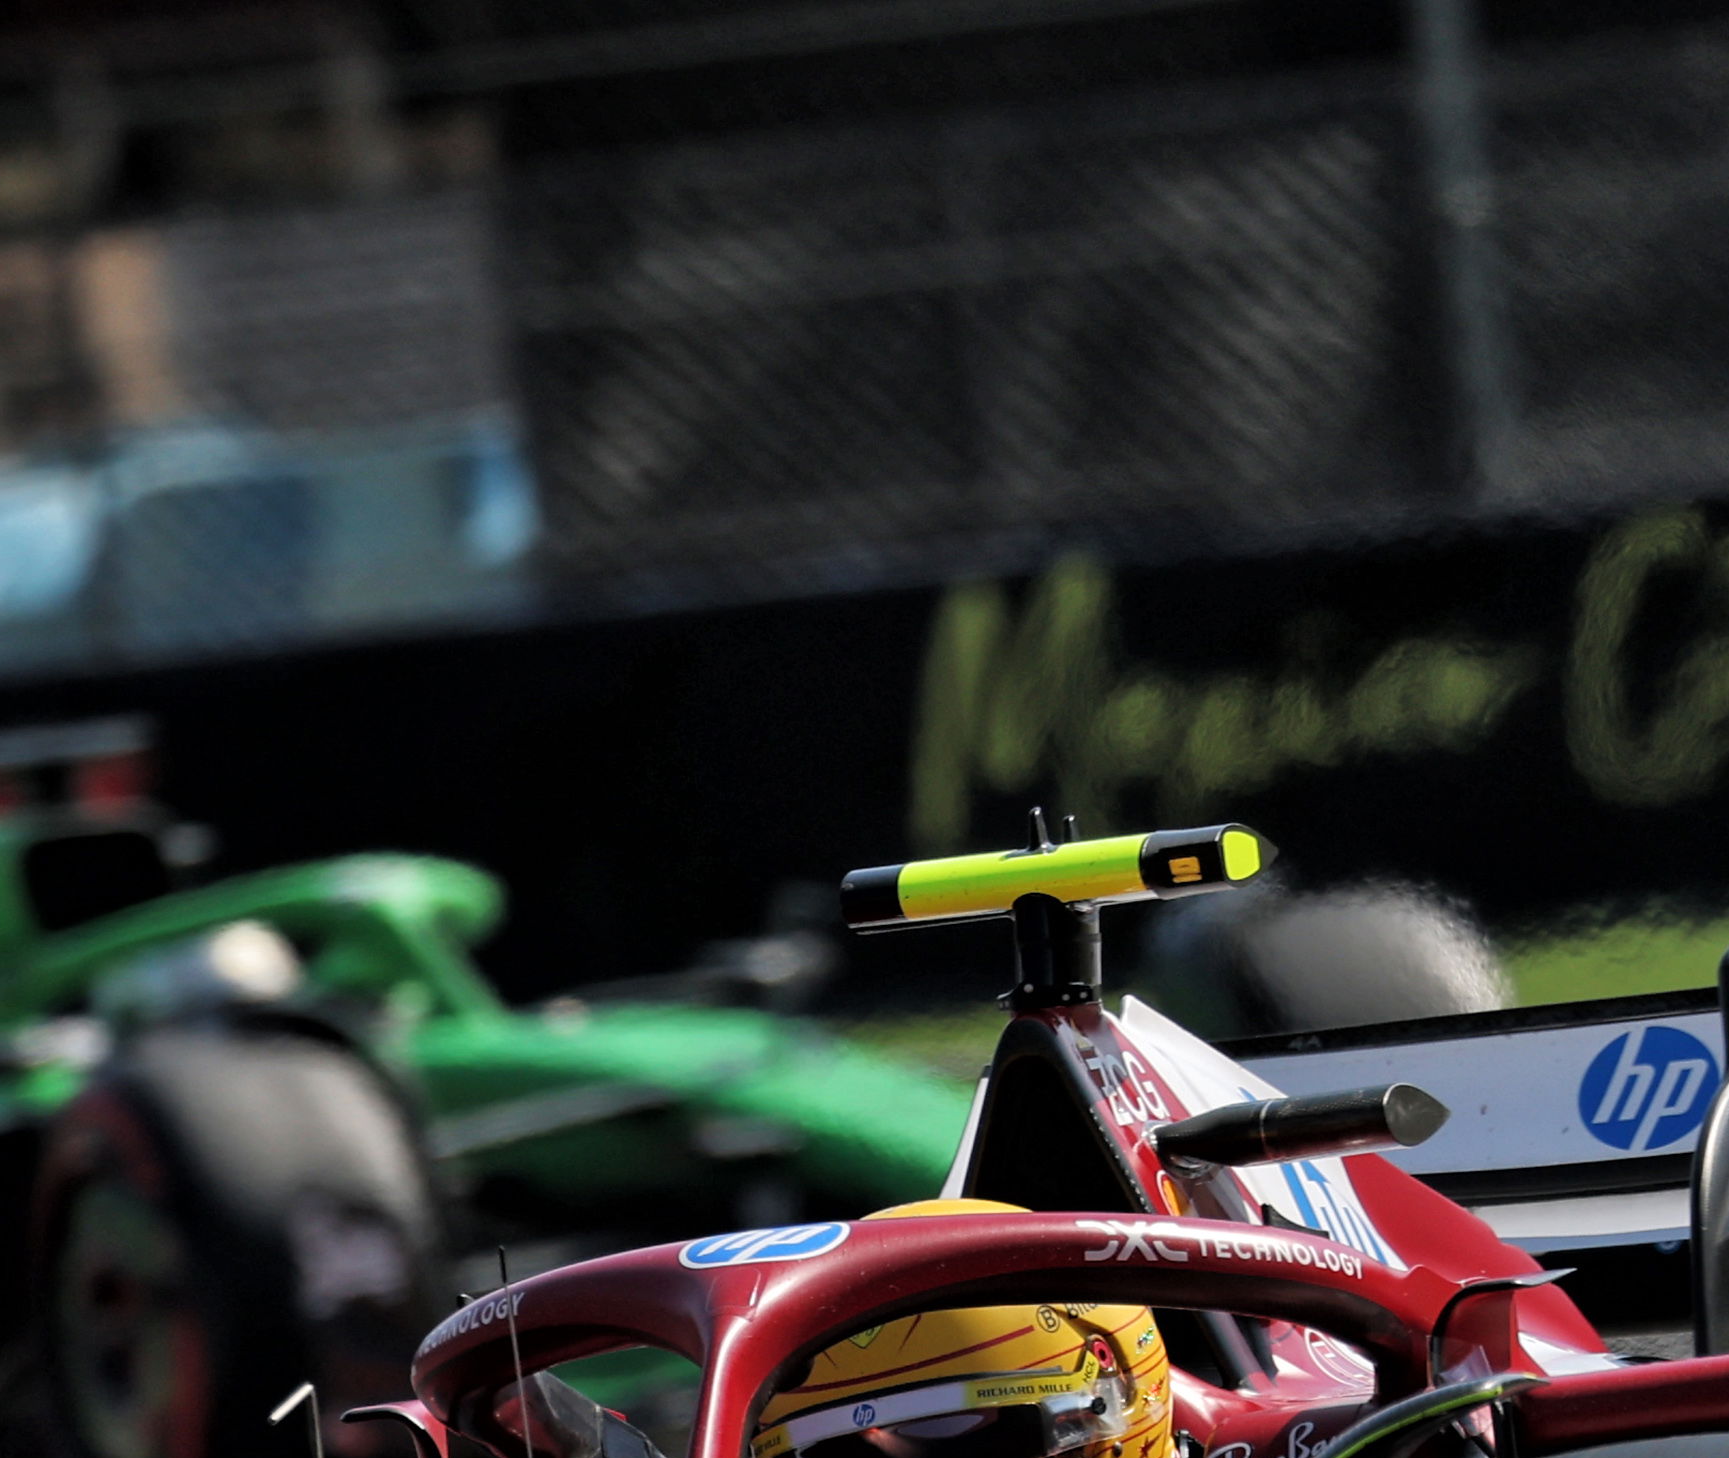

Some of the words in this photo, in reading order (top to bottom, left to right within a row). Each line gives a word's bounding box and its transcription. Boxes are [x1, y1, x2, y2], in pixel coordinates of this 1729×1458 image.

[1591, 1026, 1710, 1150] hp
[1198, 1239, 1364, 1279] TECHNOLOGY
[977, 1384, 1035, 1399] RICHARD
[1038, 1383, 1072, 1394] MILLE
[854, 1404, 875, 1427] hp
